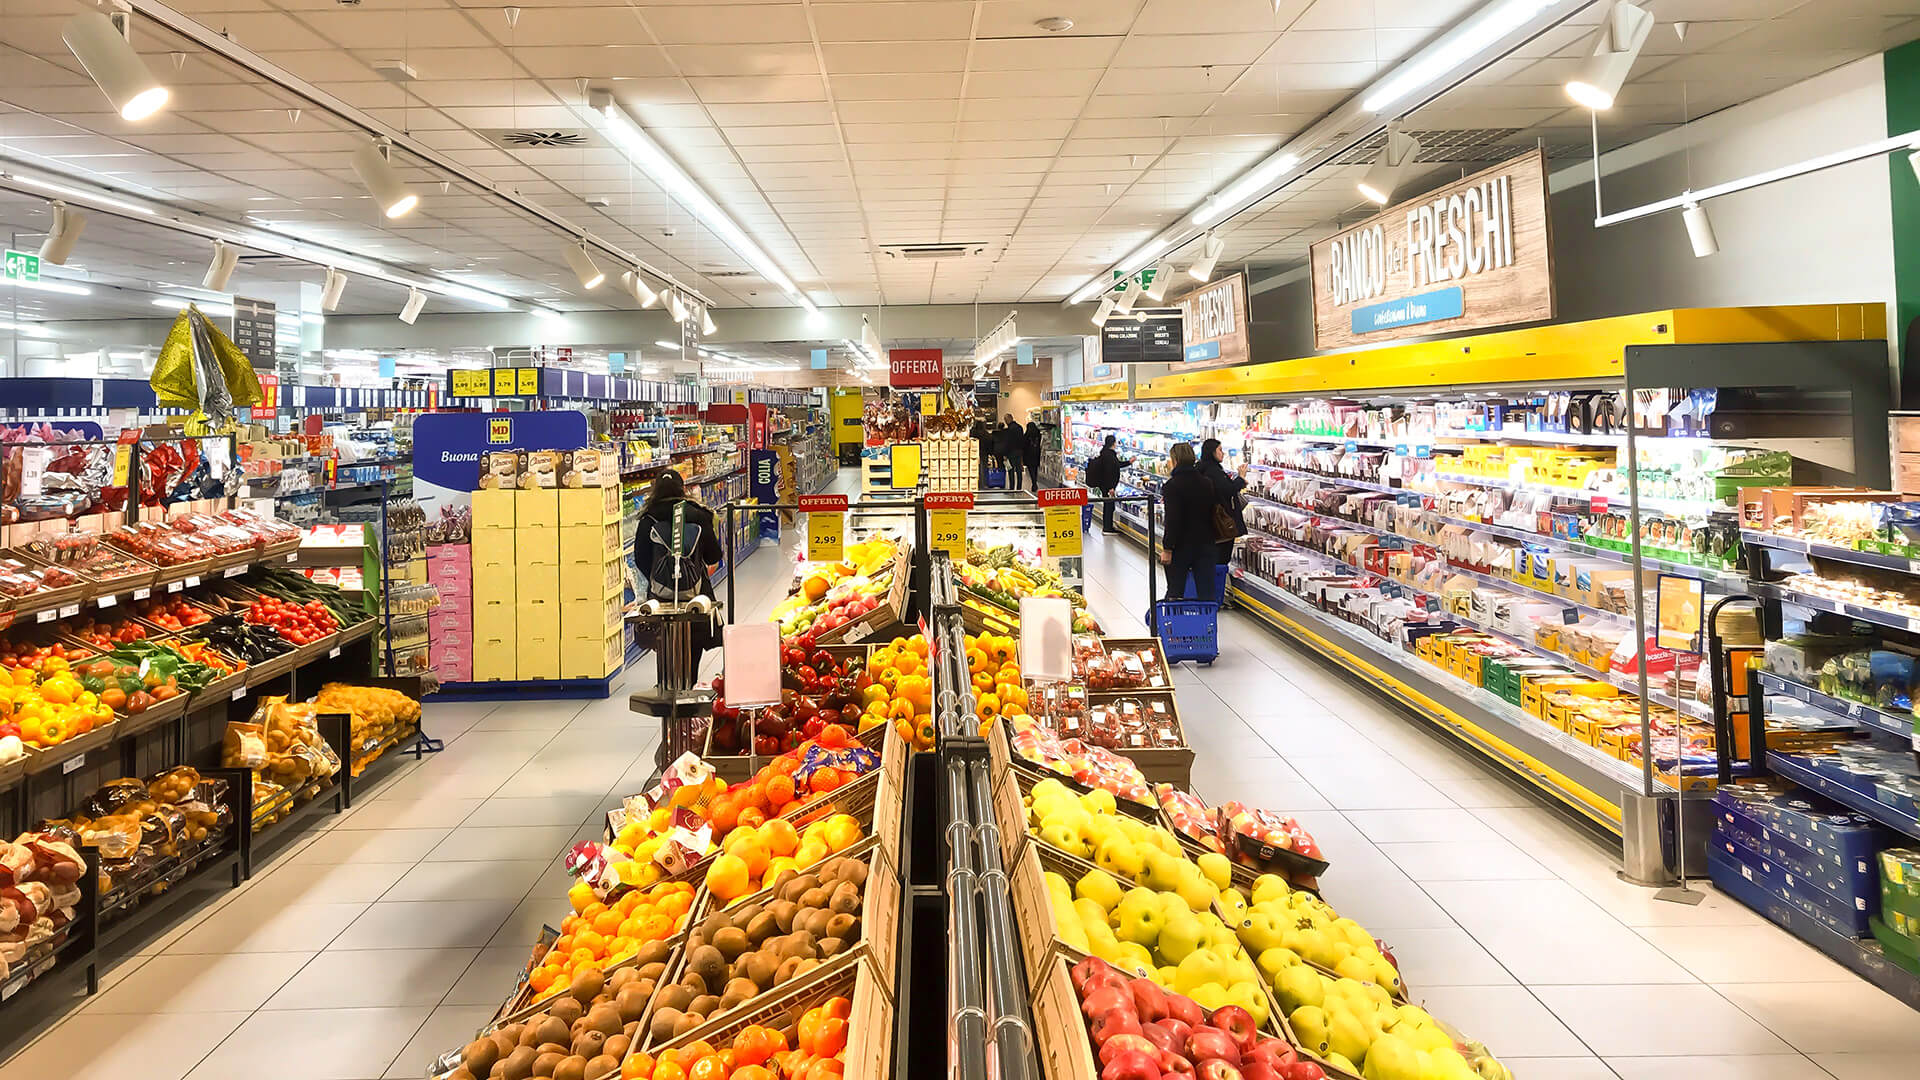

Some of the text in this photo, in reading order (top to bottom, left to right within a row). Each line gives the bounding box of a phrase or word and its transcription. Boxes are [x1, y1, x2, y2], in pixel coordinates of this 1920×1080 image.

[1332, 224, 1386, 306] BANCO
[1407, 175, 1513, 288] FRESCHI
[1199, 284, 1236, 340] FRESCHI
[892, 360, 939, 374] OFFERTA
[945, 366, 970, 378] ERIA
[492, 425, 508, 435] MD
[441, 451, 478, 462] Buona
[926, 495, 971, 503] OFFERTA
[1045, 490, 1080, 500] OFFERTA
[936, 533, 958, 542] 2,99
[1053, 530, 1074, 539] 1,69
[814, 536, 836, 544] 2,99
